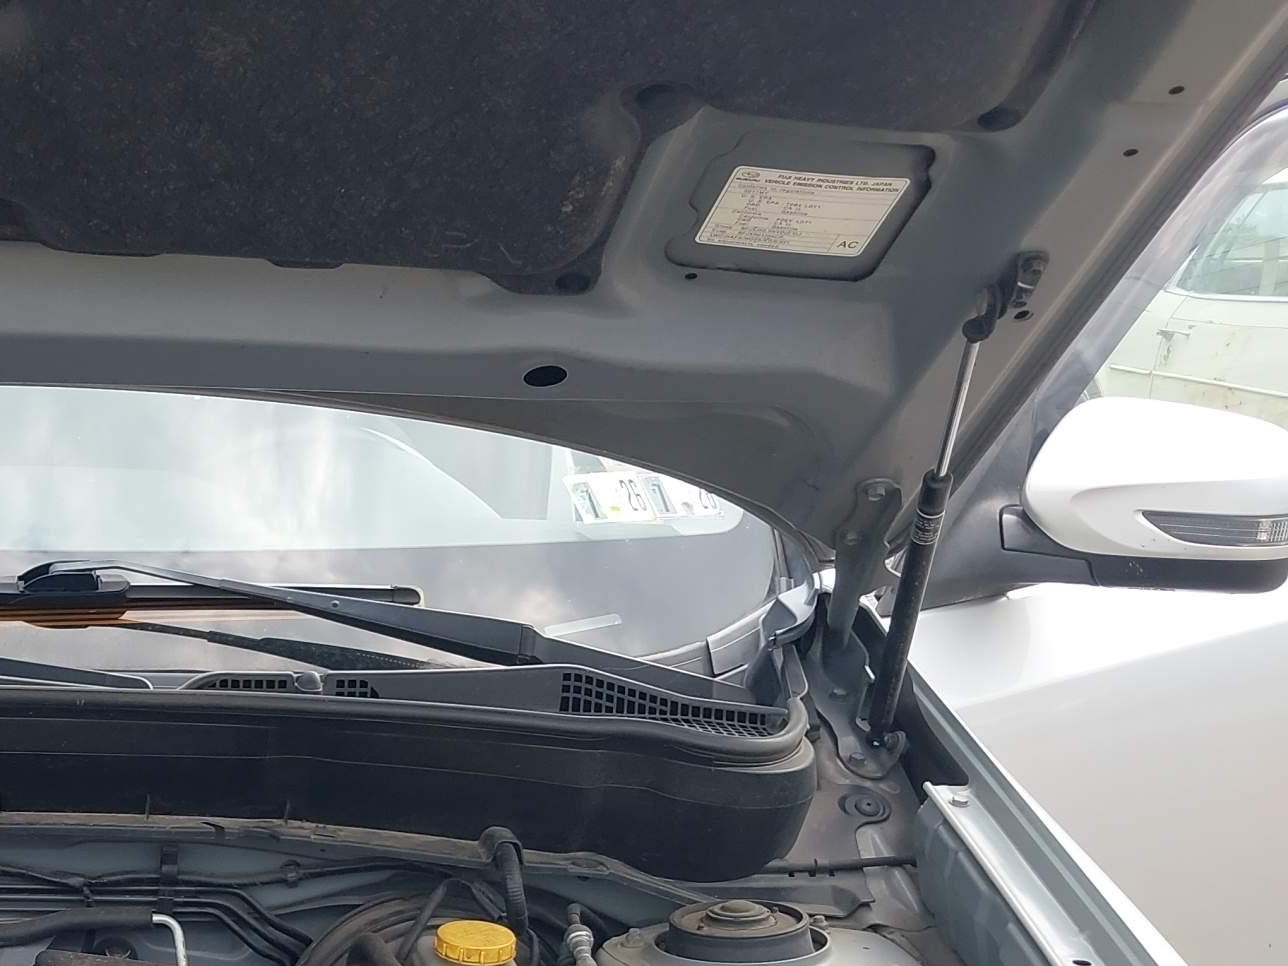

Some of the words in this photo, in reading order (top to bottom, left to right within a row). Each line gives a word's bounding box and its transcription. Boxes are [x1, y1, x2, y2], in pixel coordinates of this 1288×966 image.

[816, 177, 854, 185] INDUSTRIES
[791, 181, 824, 189] EMISSION
[824, 183, 854, 191] CONTROL
[856, 185, 899, 193] INFORMATION
[836, 240, 859, 249] AC
